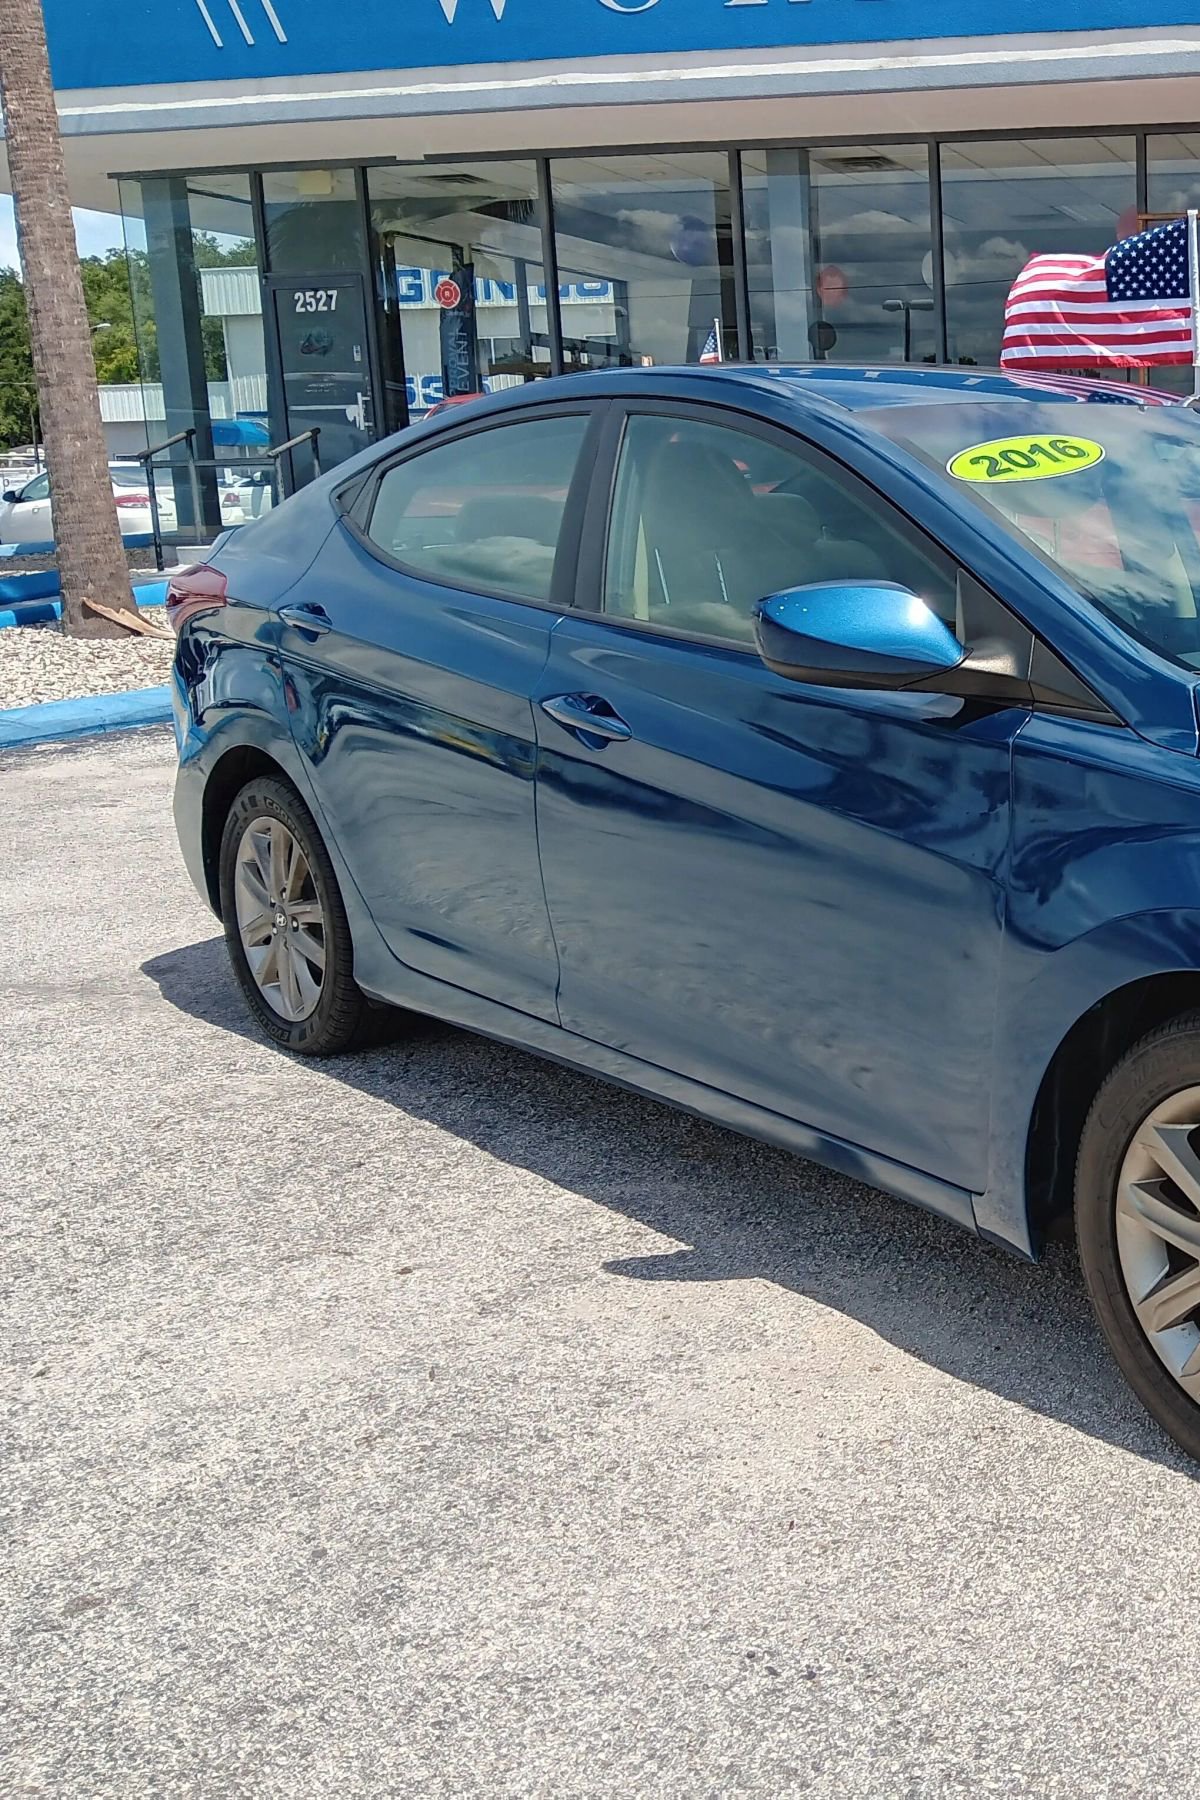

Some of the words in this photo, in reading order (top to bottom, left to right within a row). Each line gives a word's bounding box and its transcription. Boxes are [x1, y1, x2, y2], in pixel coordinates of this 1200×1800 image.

[294, 289, 338, 313] 2527
[455, 328, 470, 392] EVENT
[969, 439, 1090, 478] 2016
